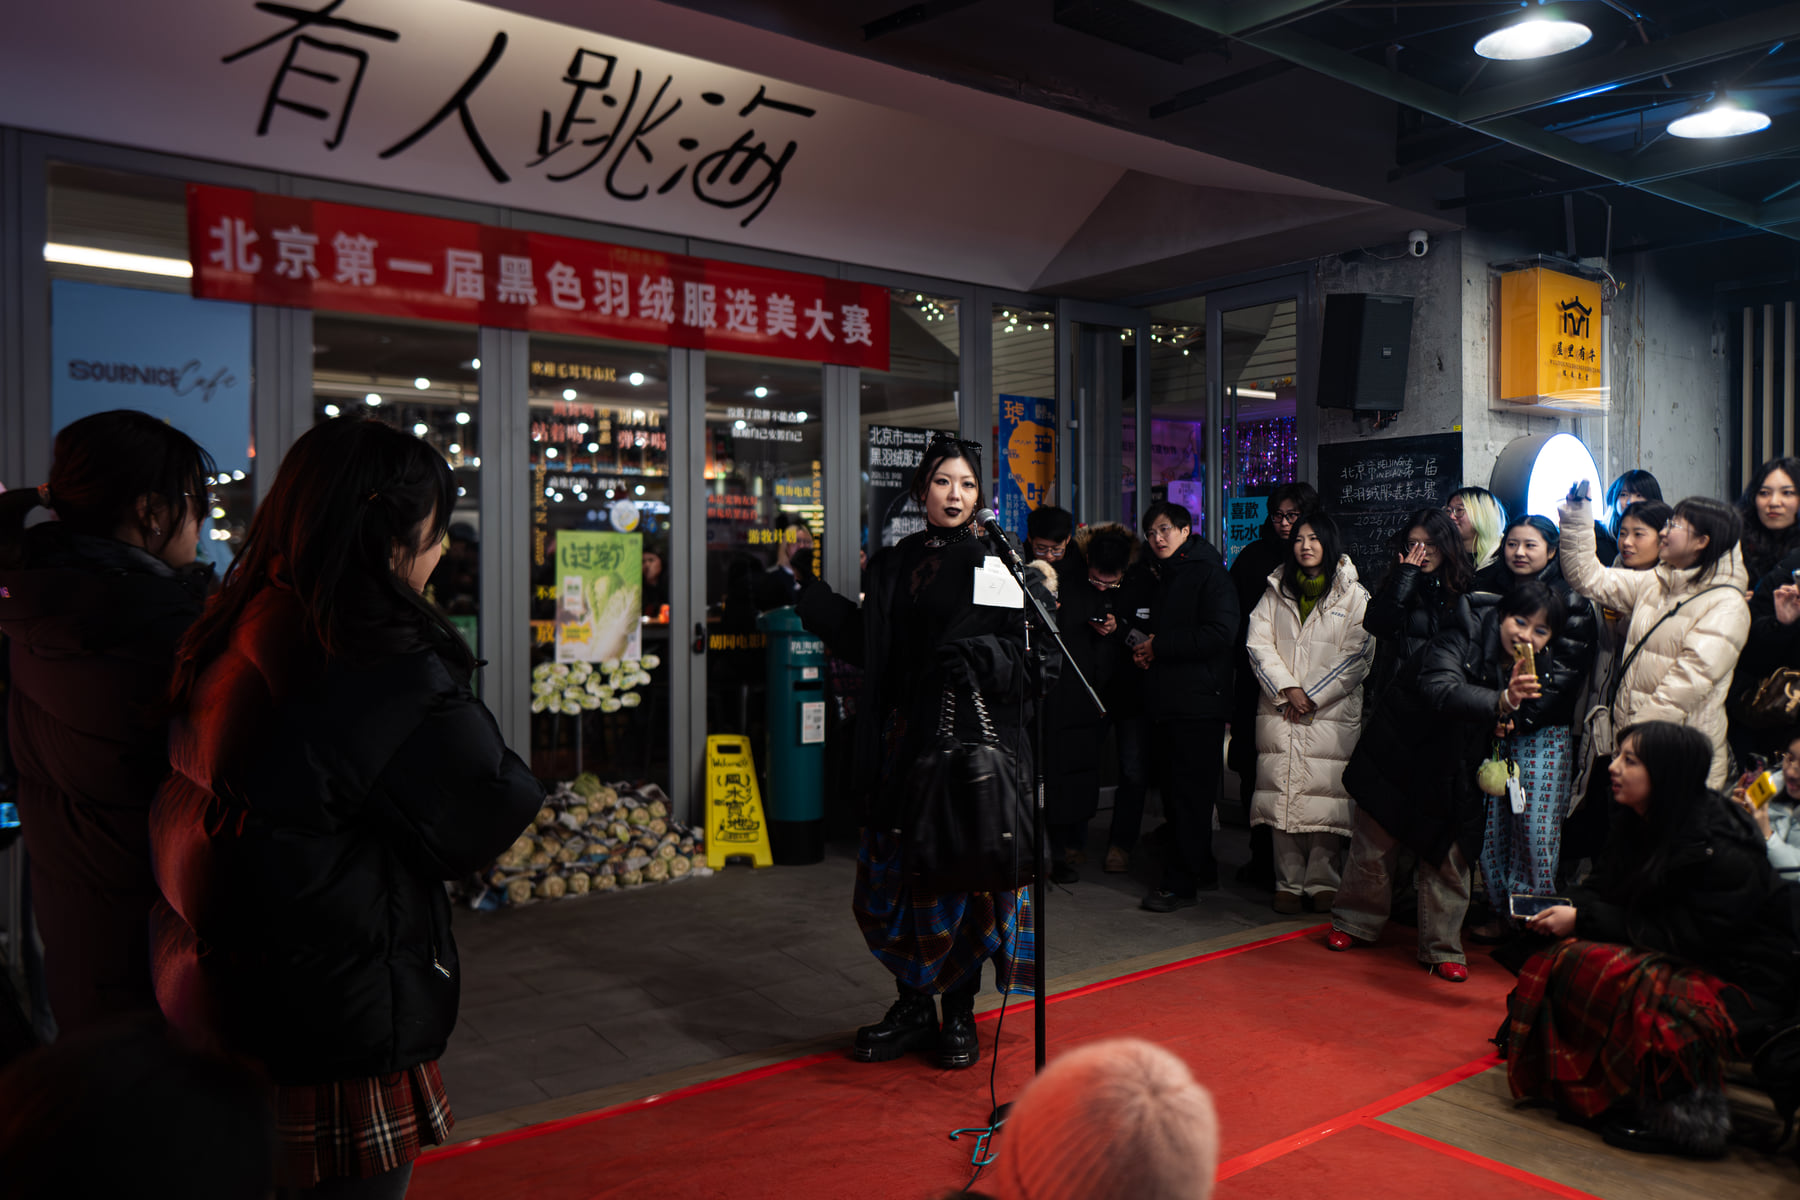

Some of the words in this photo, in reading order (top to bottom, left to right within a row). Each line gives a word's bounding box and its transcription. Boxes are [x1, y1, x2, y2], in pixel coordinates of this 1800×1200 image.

[221, 0, 816, 227] 有人跳海
[208, 217, 874, 347] 北京第一届黑色羽绒服选美大赛
[870, 427, 903, 447] 北京市
[1340, 462, 1376, 480] 北京市
[1231, 501, 1259, 520] 喜歡
[748, 528, 797, 545] 游牧计划
[1230, 523, 1263, 541] 玩水
